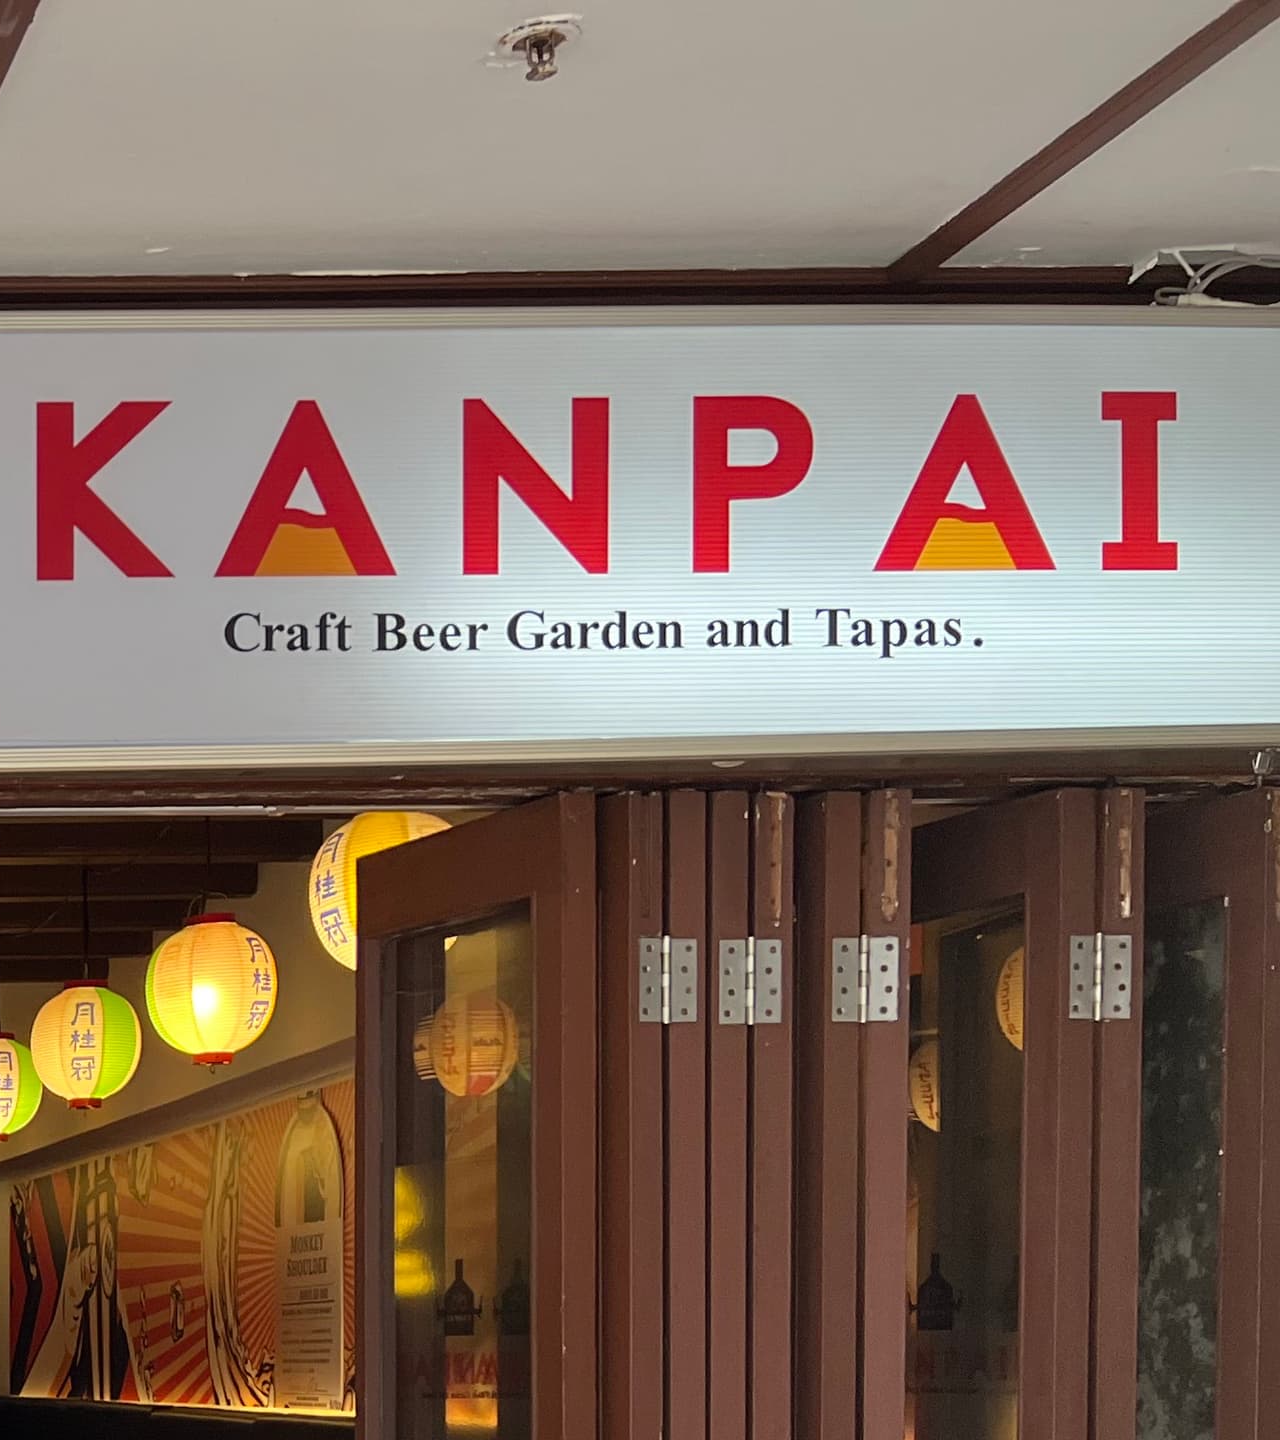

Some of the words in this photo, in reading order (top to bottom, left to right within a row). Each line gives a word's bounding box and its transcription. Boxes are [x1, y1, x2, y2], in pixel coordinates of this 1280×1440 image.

[36, 391, 1179, 581] KANPAI
[223, 610, 352, 654] Craft
[373, 611, 488, 654] Beer
[506, 609, 685, 653] Garden
[705, 607, 792, 650] and
[815, 607, 985, 659] Tapas.
[290, 1233, 324, 1251] MONKEY
[287, 1257, 328, 1277] SHOULDER
